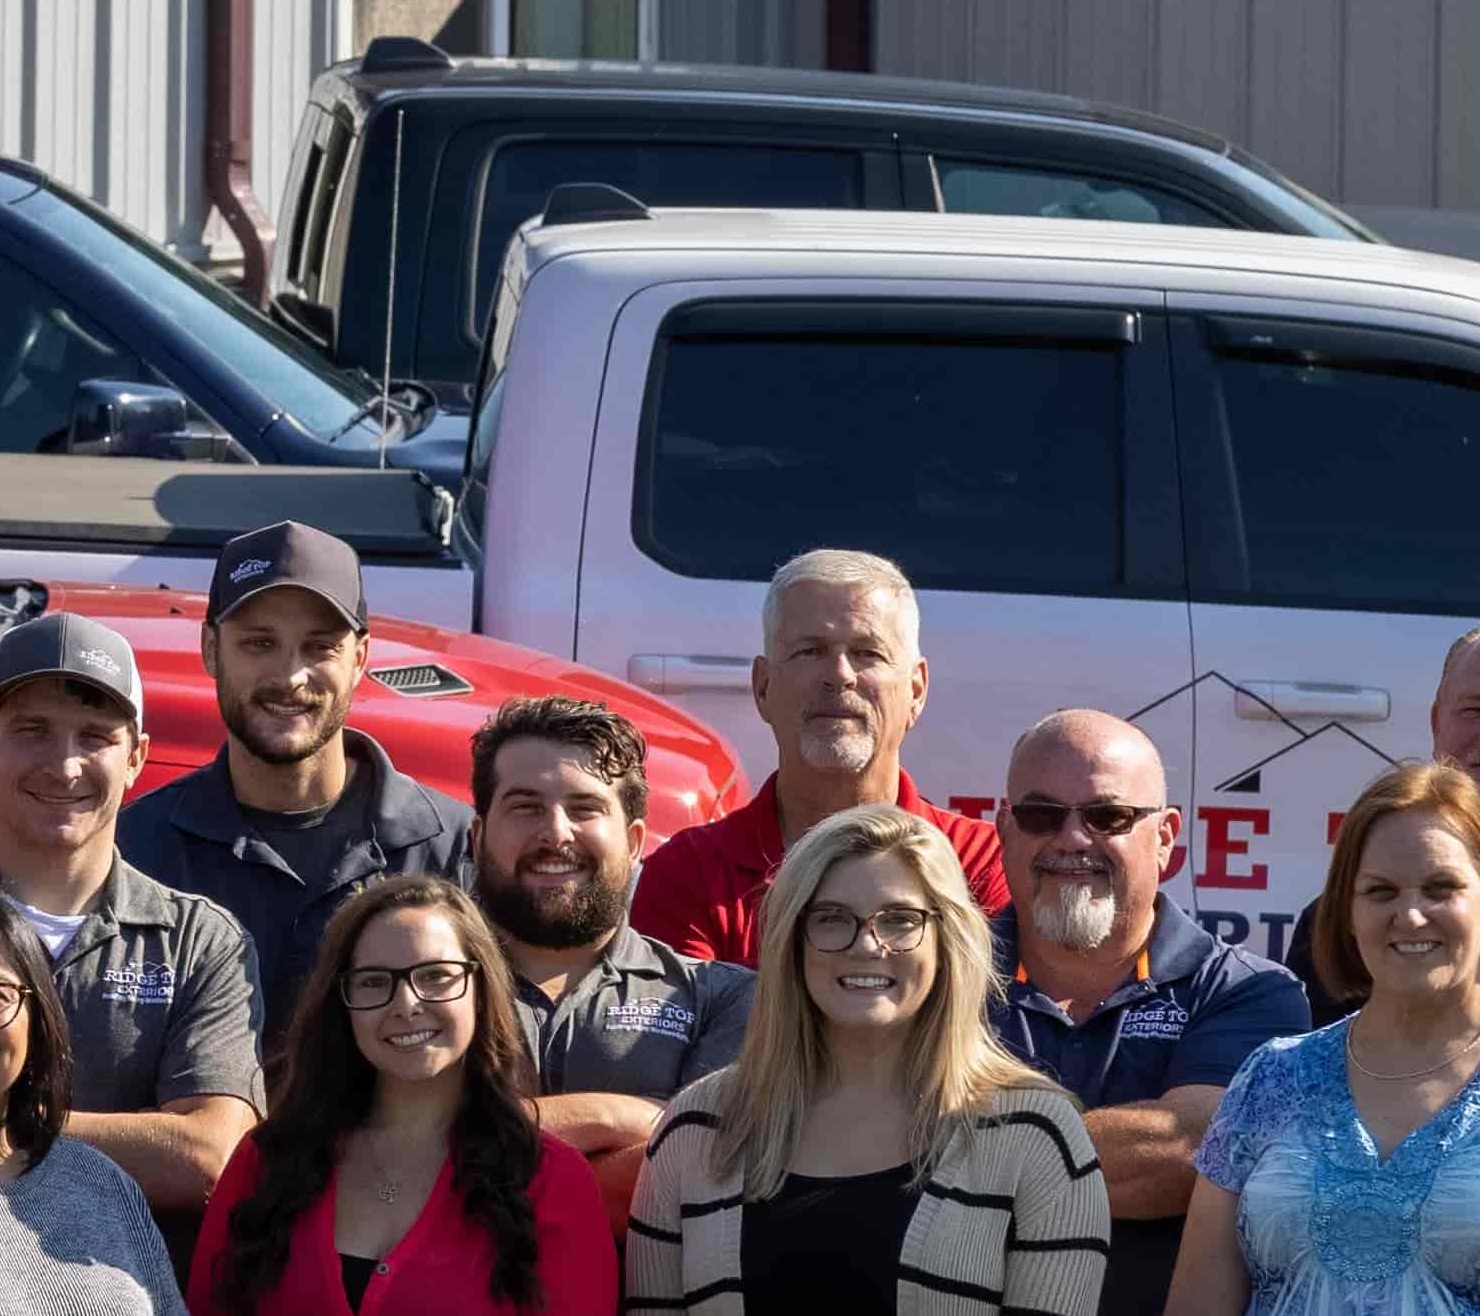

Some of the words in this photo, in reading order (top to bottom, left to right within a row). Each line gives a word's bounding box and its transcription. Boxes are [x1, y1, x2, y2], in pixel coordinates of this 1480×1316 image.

[104, 969, 158, 986] RIDGE
[607, 1004, 661, 1016] RIDGE
[621, 1015, 685, 1032] EXTERIORS
